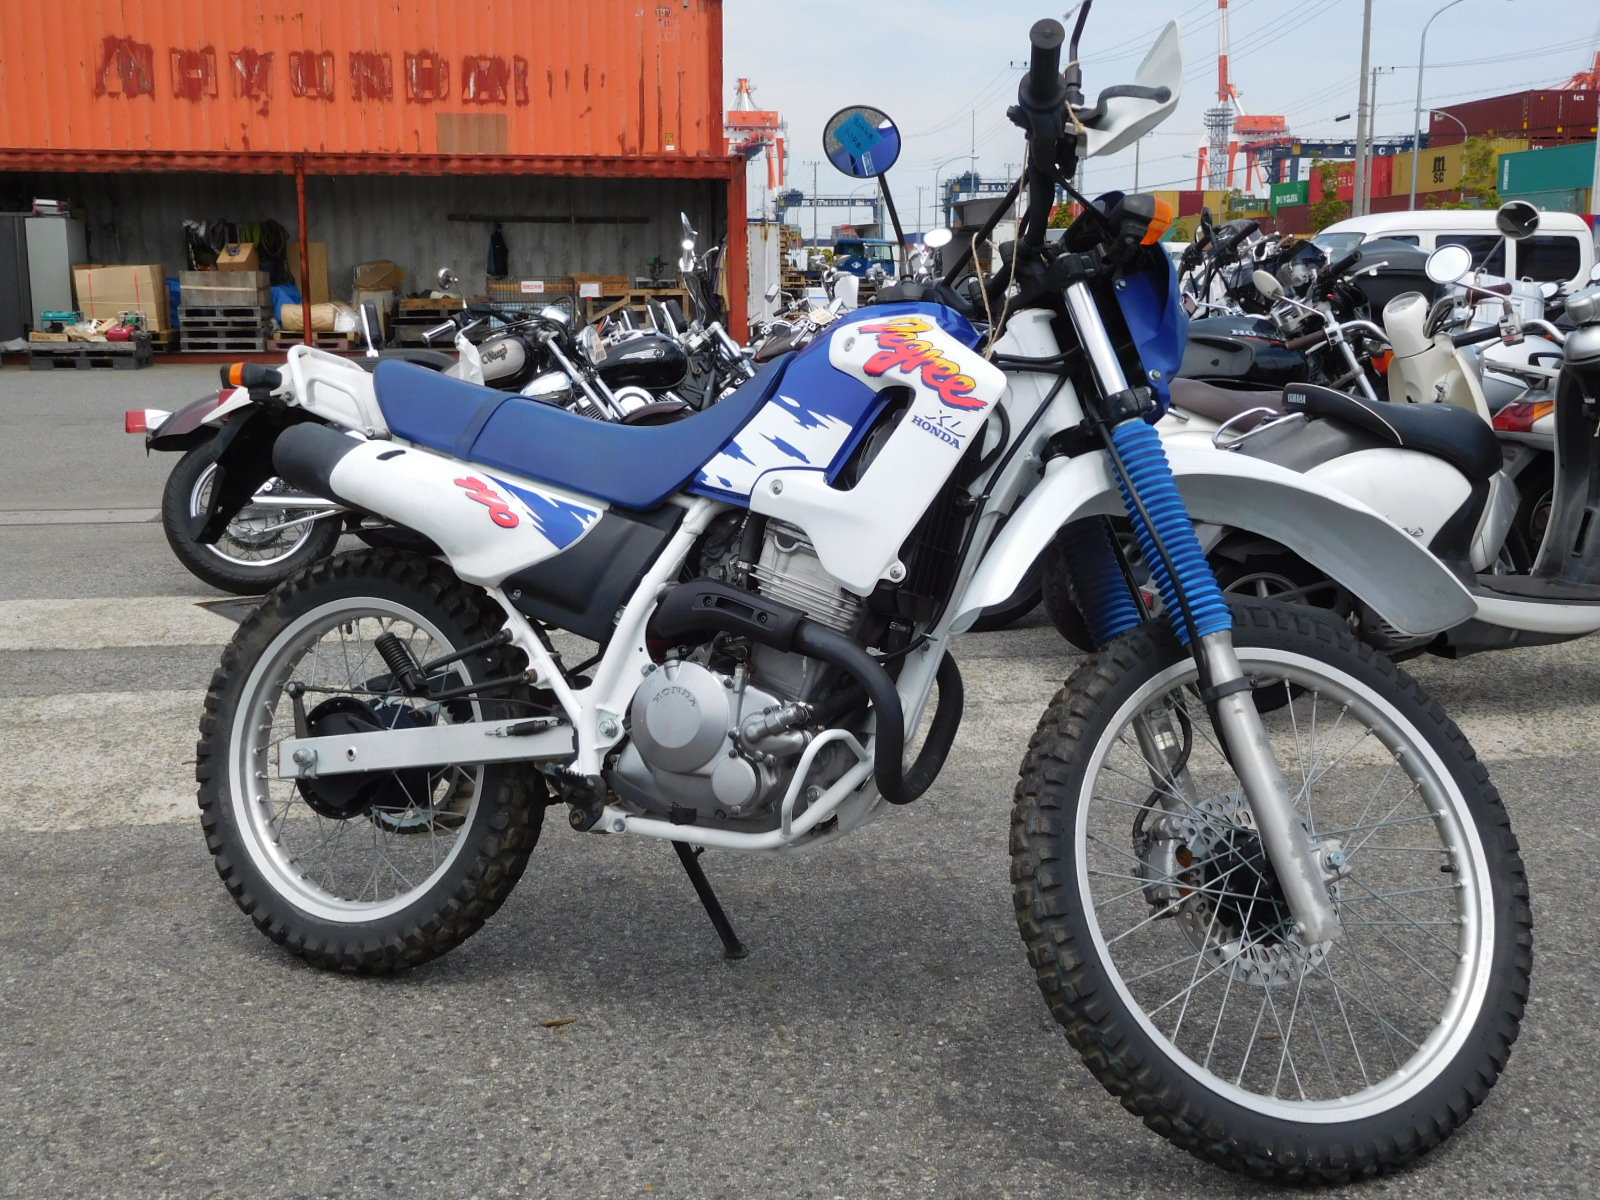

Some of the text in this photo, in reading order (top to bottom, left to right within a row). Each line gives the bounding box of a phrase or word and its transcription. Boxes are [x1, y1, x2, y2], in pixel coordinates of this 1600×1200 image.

[858, 318, 988, 412] Degree
[1287, 393, 1306, 405] YAMAHA
[911, 415, 961, 449] HONDA
[652, 686, 696, 707] HONDA
